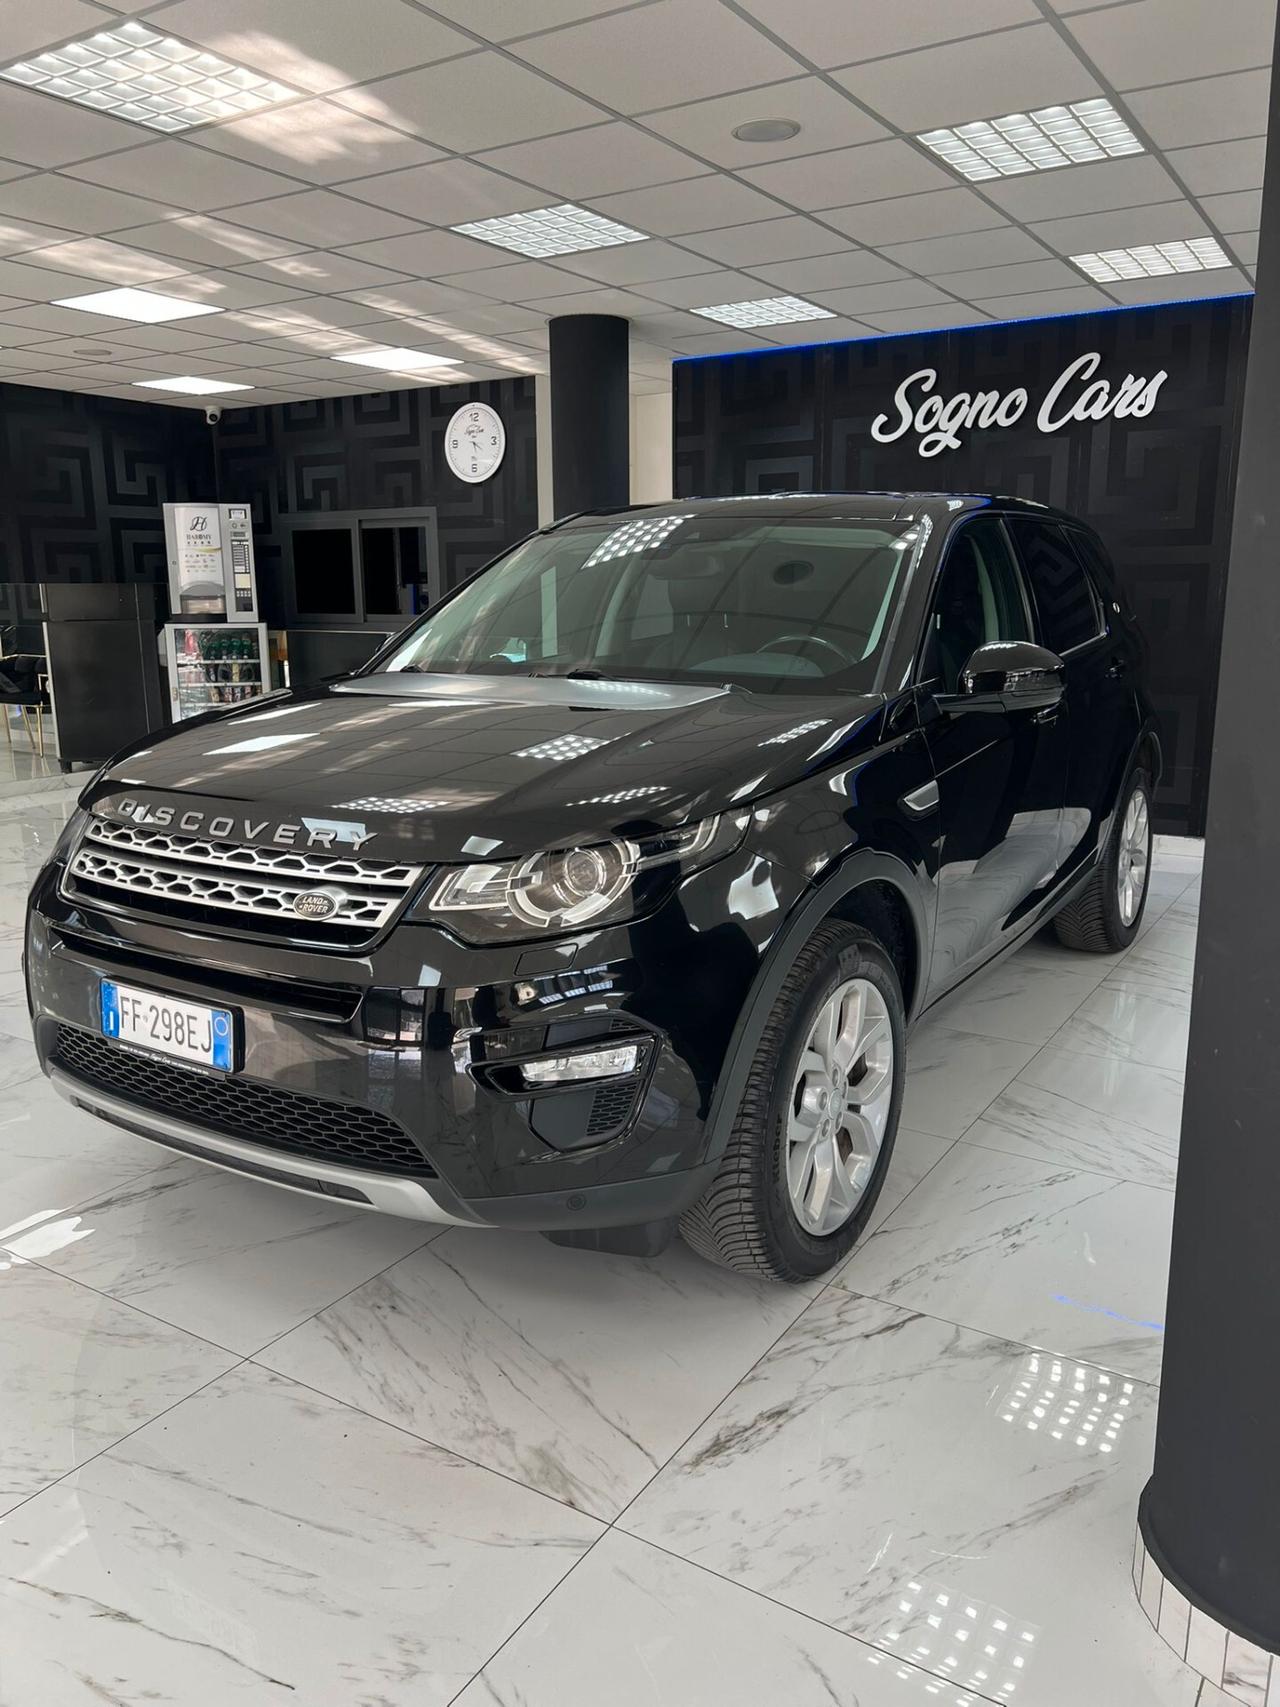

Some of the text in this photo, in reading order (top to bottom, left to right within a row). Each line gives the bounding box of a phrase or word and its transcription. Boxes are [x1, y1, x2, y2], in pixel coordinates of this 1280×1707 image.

[870, 351, 1169, 458] Sogno Cars
[469, 412, 479, 422] 12
[452, 439, 458, 449] 9
[490, 436, 497, 446] 3
[471, 463, 478, 473] 6
[117, 798, 378, 851] DISCOVERY
[302, 896, 324, 905] LAND
[303, 904, 329, 914] ROVER
